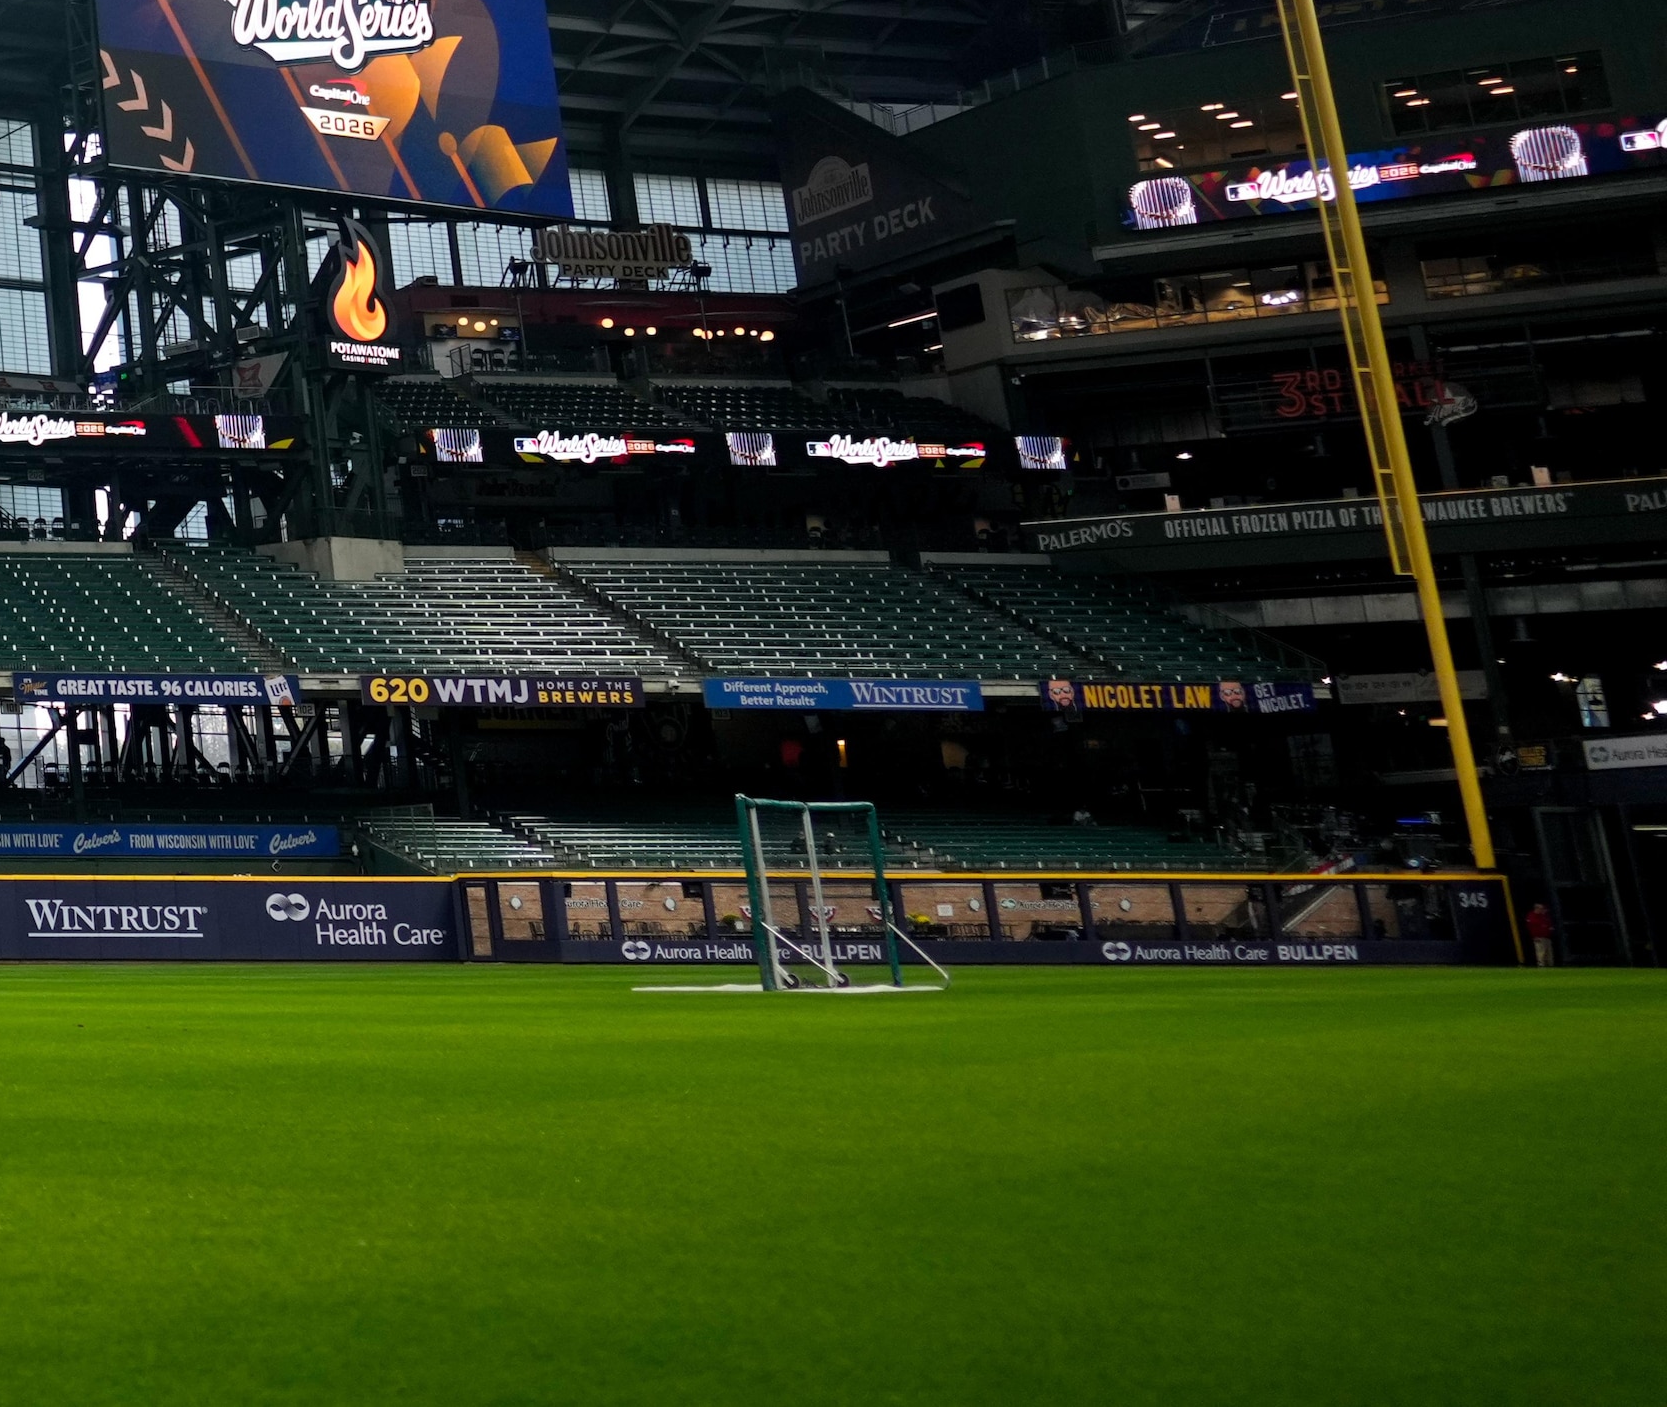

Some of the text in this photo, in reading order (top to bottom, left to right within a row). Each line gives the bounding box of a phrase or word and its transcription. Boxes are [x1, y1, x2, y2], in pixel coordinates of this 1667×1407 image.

[318, 115, 375, 136] 2026
[1380, 167, 1418, 180] 2026
[798, 170, 868, 221] Johnsonville
[799, 196, 935, 266] PARTY DECK
[532, 224, 692, 263] Johnsonville
[562, 264, 668, 278] PARTY DECK
[330, 342, 400, 359] POTAWATOMI
[1164, 493, 1567, 539] OFFICIAL FROZEN PIZZA OF BREWERS
[1037, 520, 1133, 551] PALERMO'S
[56, 679, 262, 697] GREAT TASTE. 96 CALORIES.
[369, 677, 529, 704] 620 WTMJ
[536, 681, 631, 691] HOME OF THE
[723, 681, 829, 696] Different Approach,
[849, 681, 967, 704] WINTRUST
[1082, 684, 1212, 709] NICOLET LAW
[1254, 682, 1275, 699] GET
[538, 691, 634, 704] BREWERS
[740, 695, 816, 707] Better Results
[13, 834, 33, 849] WITH
[34, 834, 60, 849] LOVE
[73, 828, 121, 854] Culver's
[129, 834, 154, 849] FROM
[155, 834, 207, 850] WISCONSIN
[209, 834, 229, 850] WITH
[231, 835, 255, 850] LOVE
[269, 829, 317, 855] Culver's
[315, 899, 387, 921] Aurora
[1459, 892, 1488, 909] 345
[25, 899, 203, 932] WINTRUST
[316, 922, 443, 946] Health Care
[655, 942, 702, 960] Aurora
[706, 942, 752, 960] Health
[1134, 944, 1358, 962] Aurora Health Care BULLPEN
